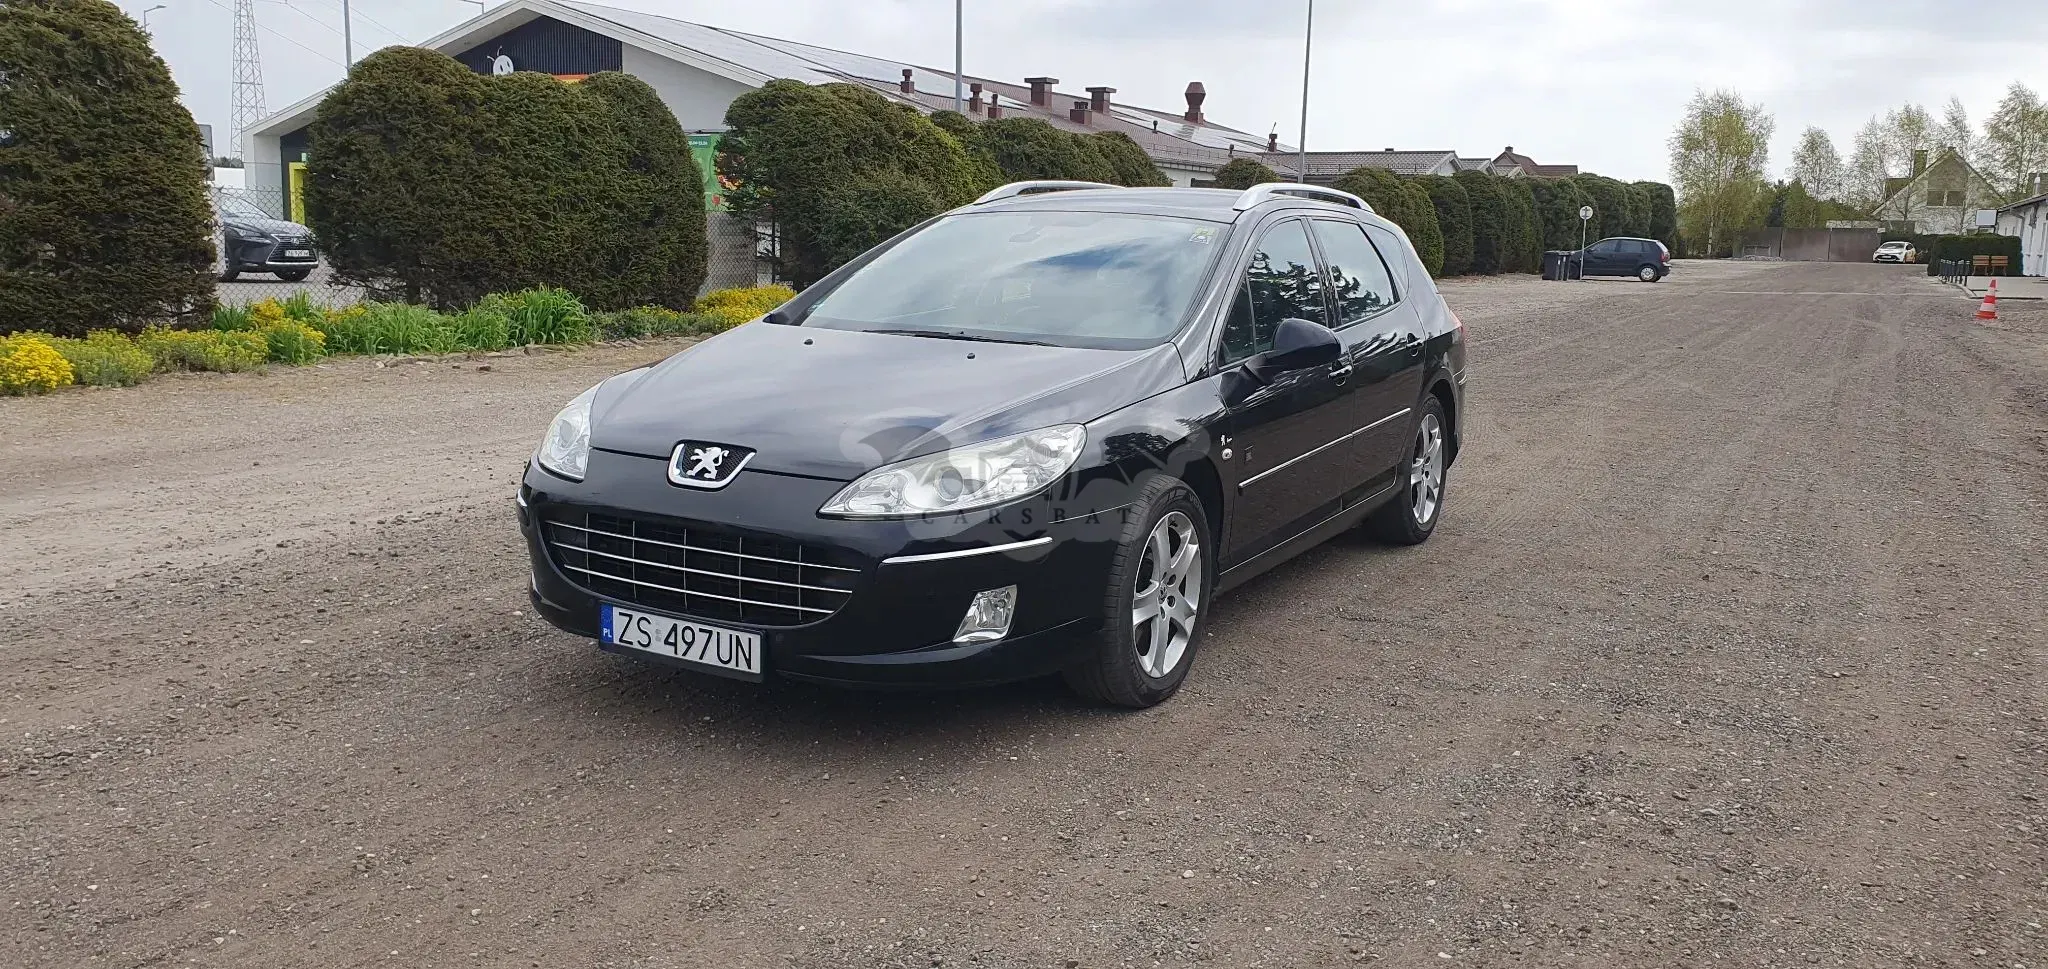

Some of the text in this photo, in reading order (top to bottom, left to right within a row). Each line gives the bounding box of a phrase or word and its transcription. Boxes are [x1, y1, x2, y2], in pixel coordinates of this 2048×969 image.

[603, 627, 612, 638] PL
[618, 611, 752, 670] ZS 497UN
